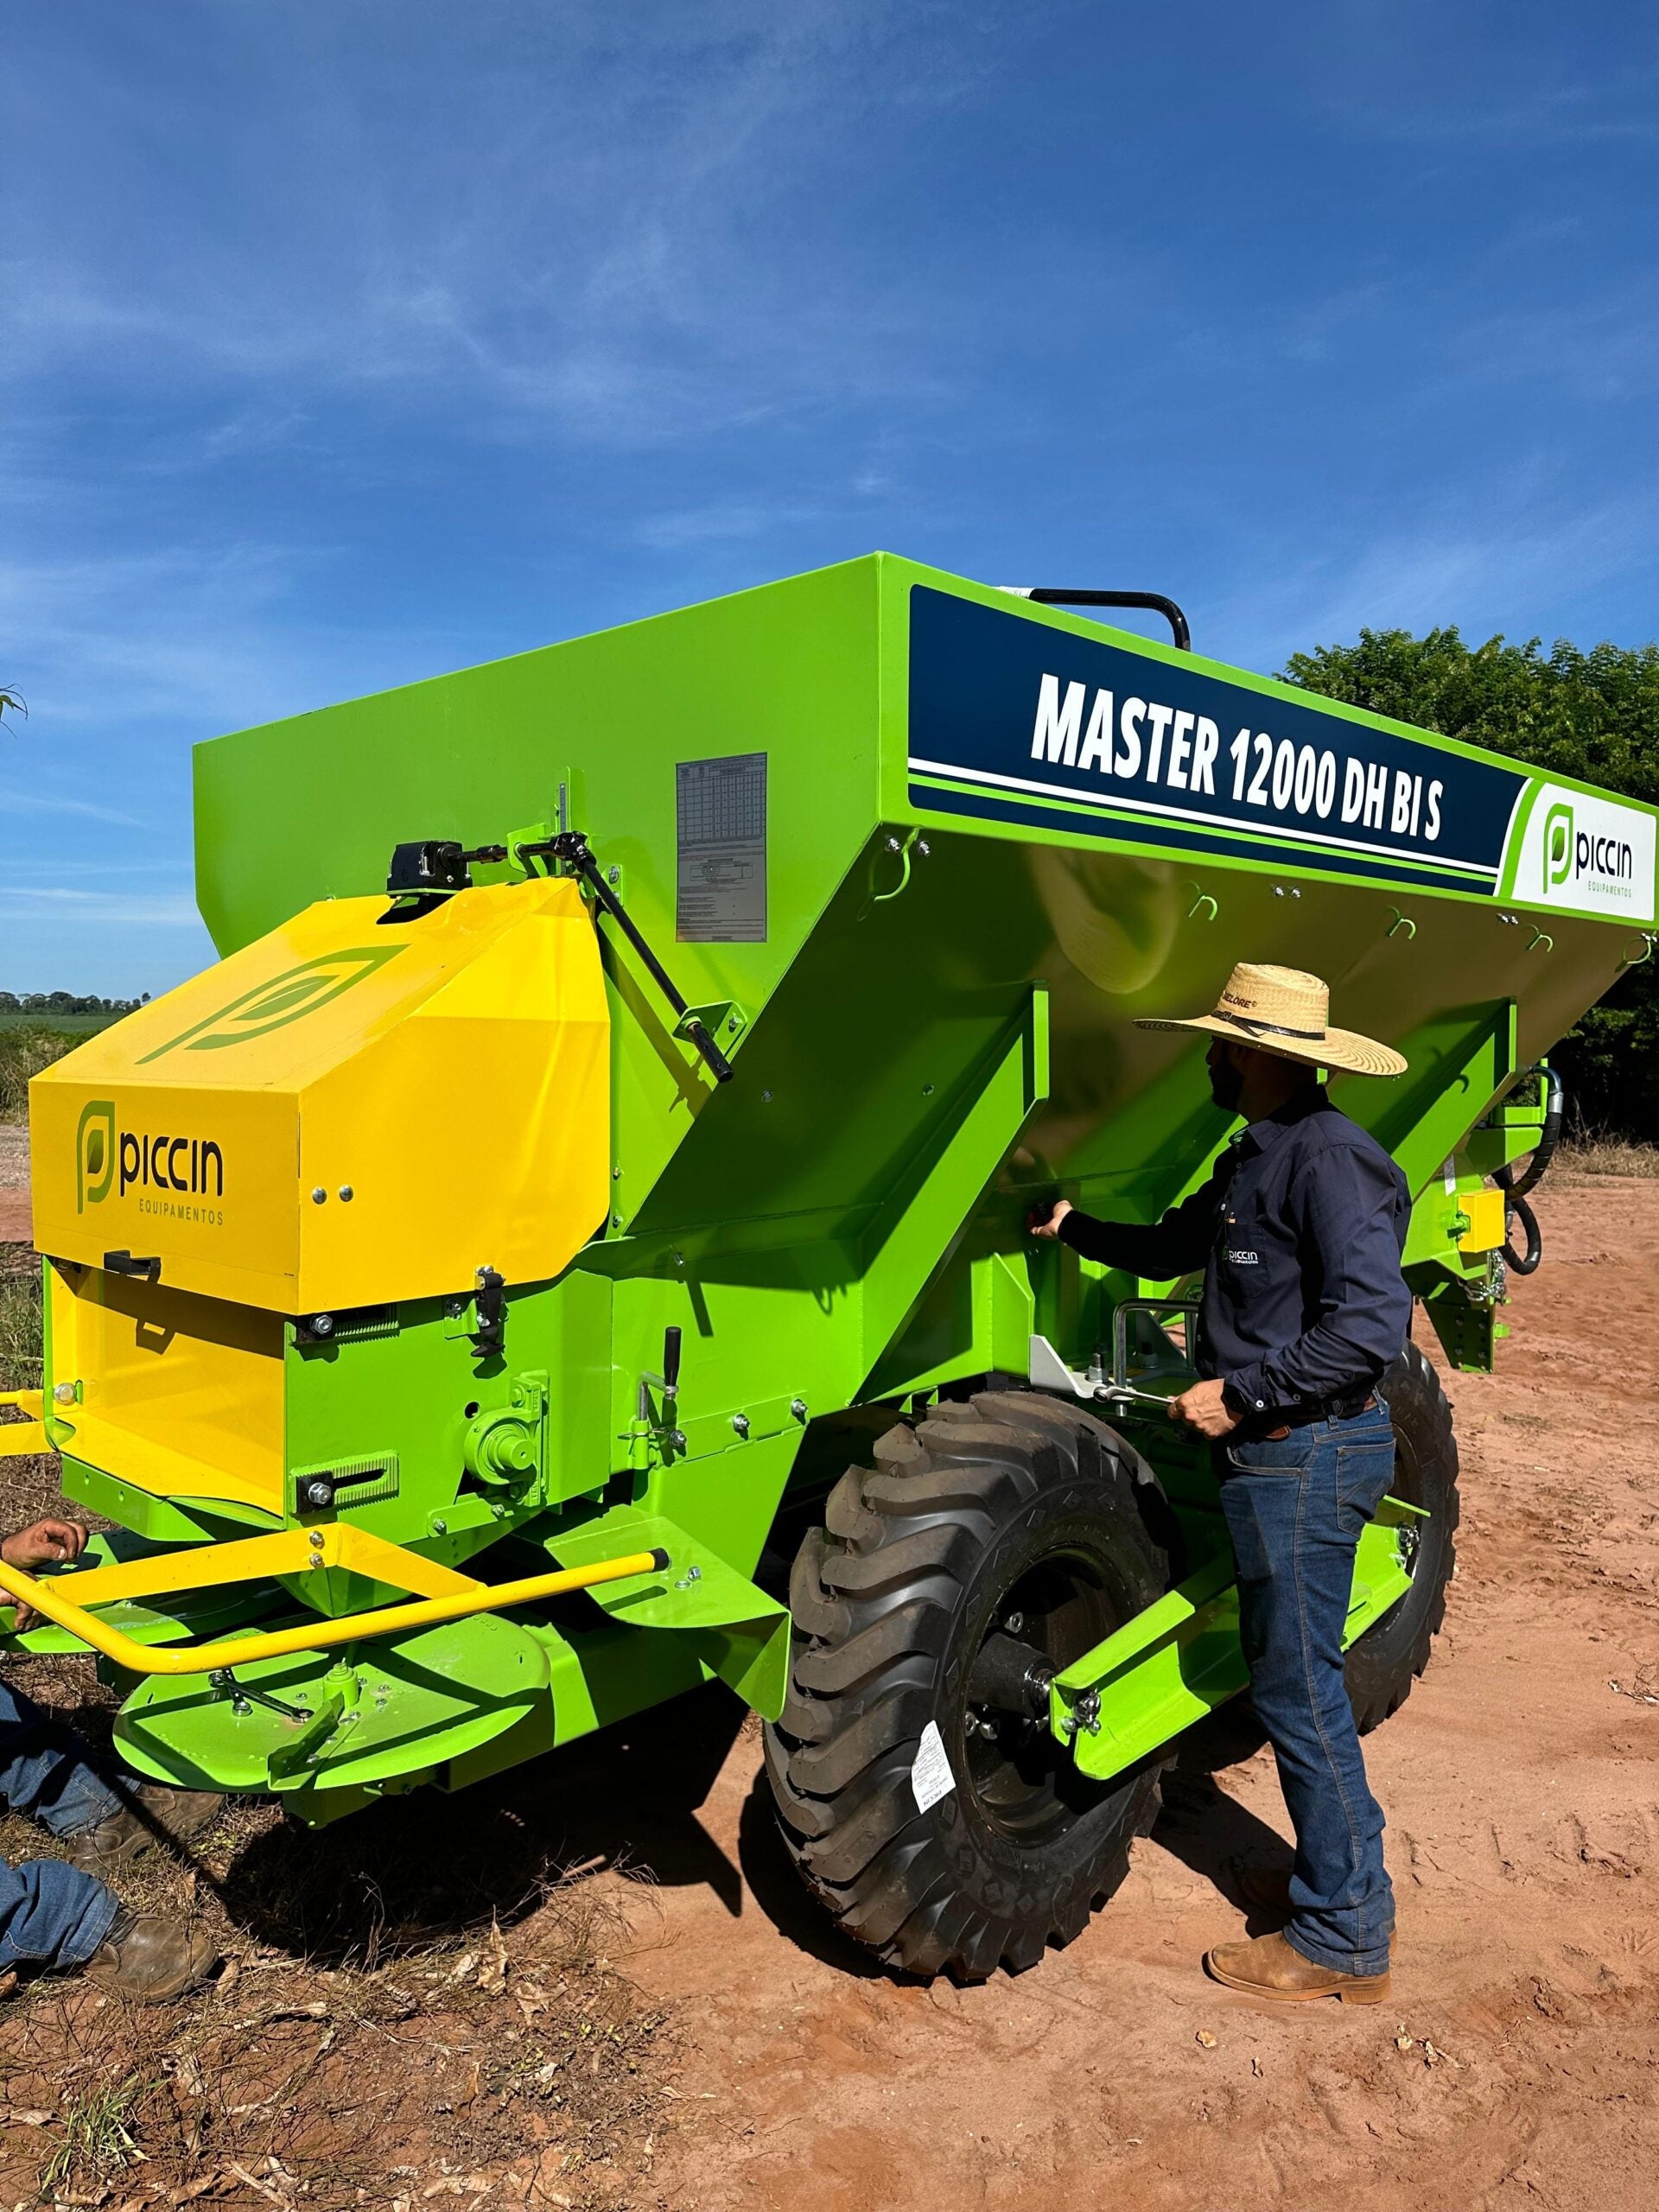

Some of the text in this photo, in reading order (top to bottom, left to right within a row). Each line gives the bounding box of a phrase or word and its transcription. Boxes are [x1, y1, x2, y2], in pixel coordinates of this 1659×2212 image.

[1031, 673, 1444, 841] MASTER 12000 DH BI S
[1576, 831, 1632, 880] piccin
[1588, 880, 1632, 899] EQUIPAMENTOS
[120, 1132, 223, 1198] piccin
[139, 1198, 223, 1226] EQUIPAMENTOS
[1228, 1250, 1259, 1261] piccin
